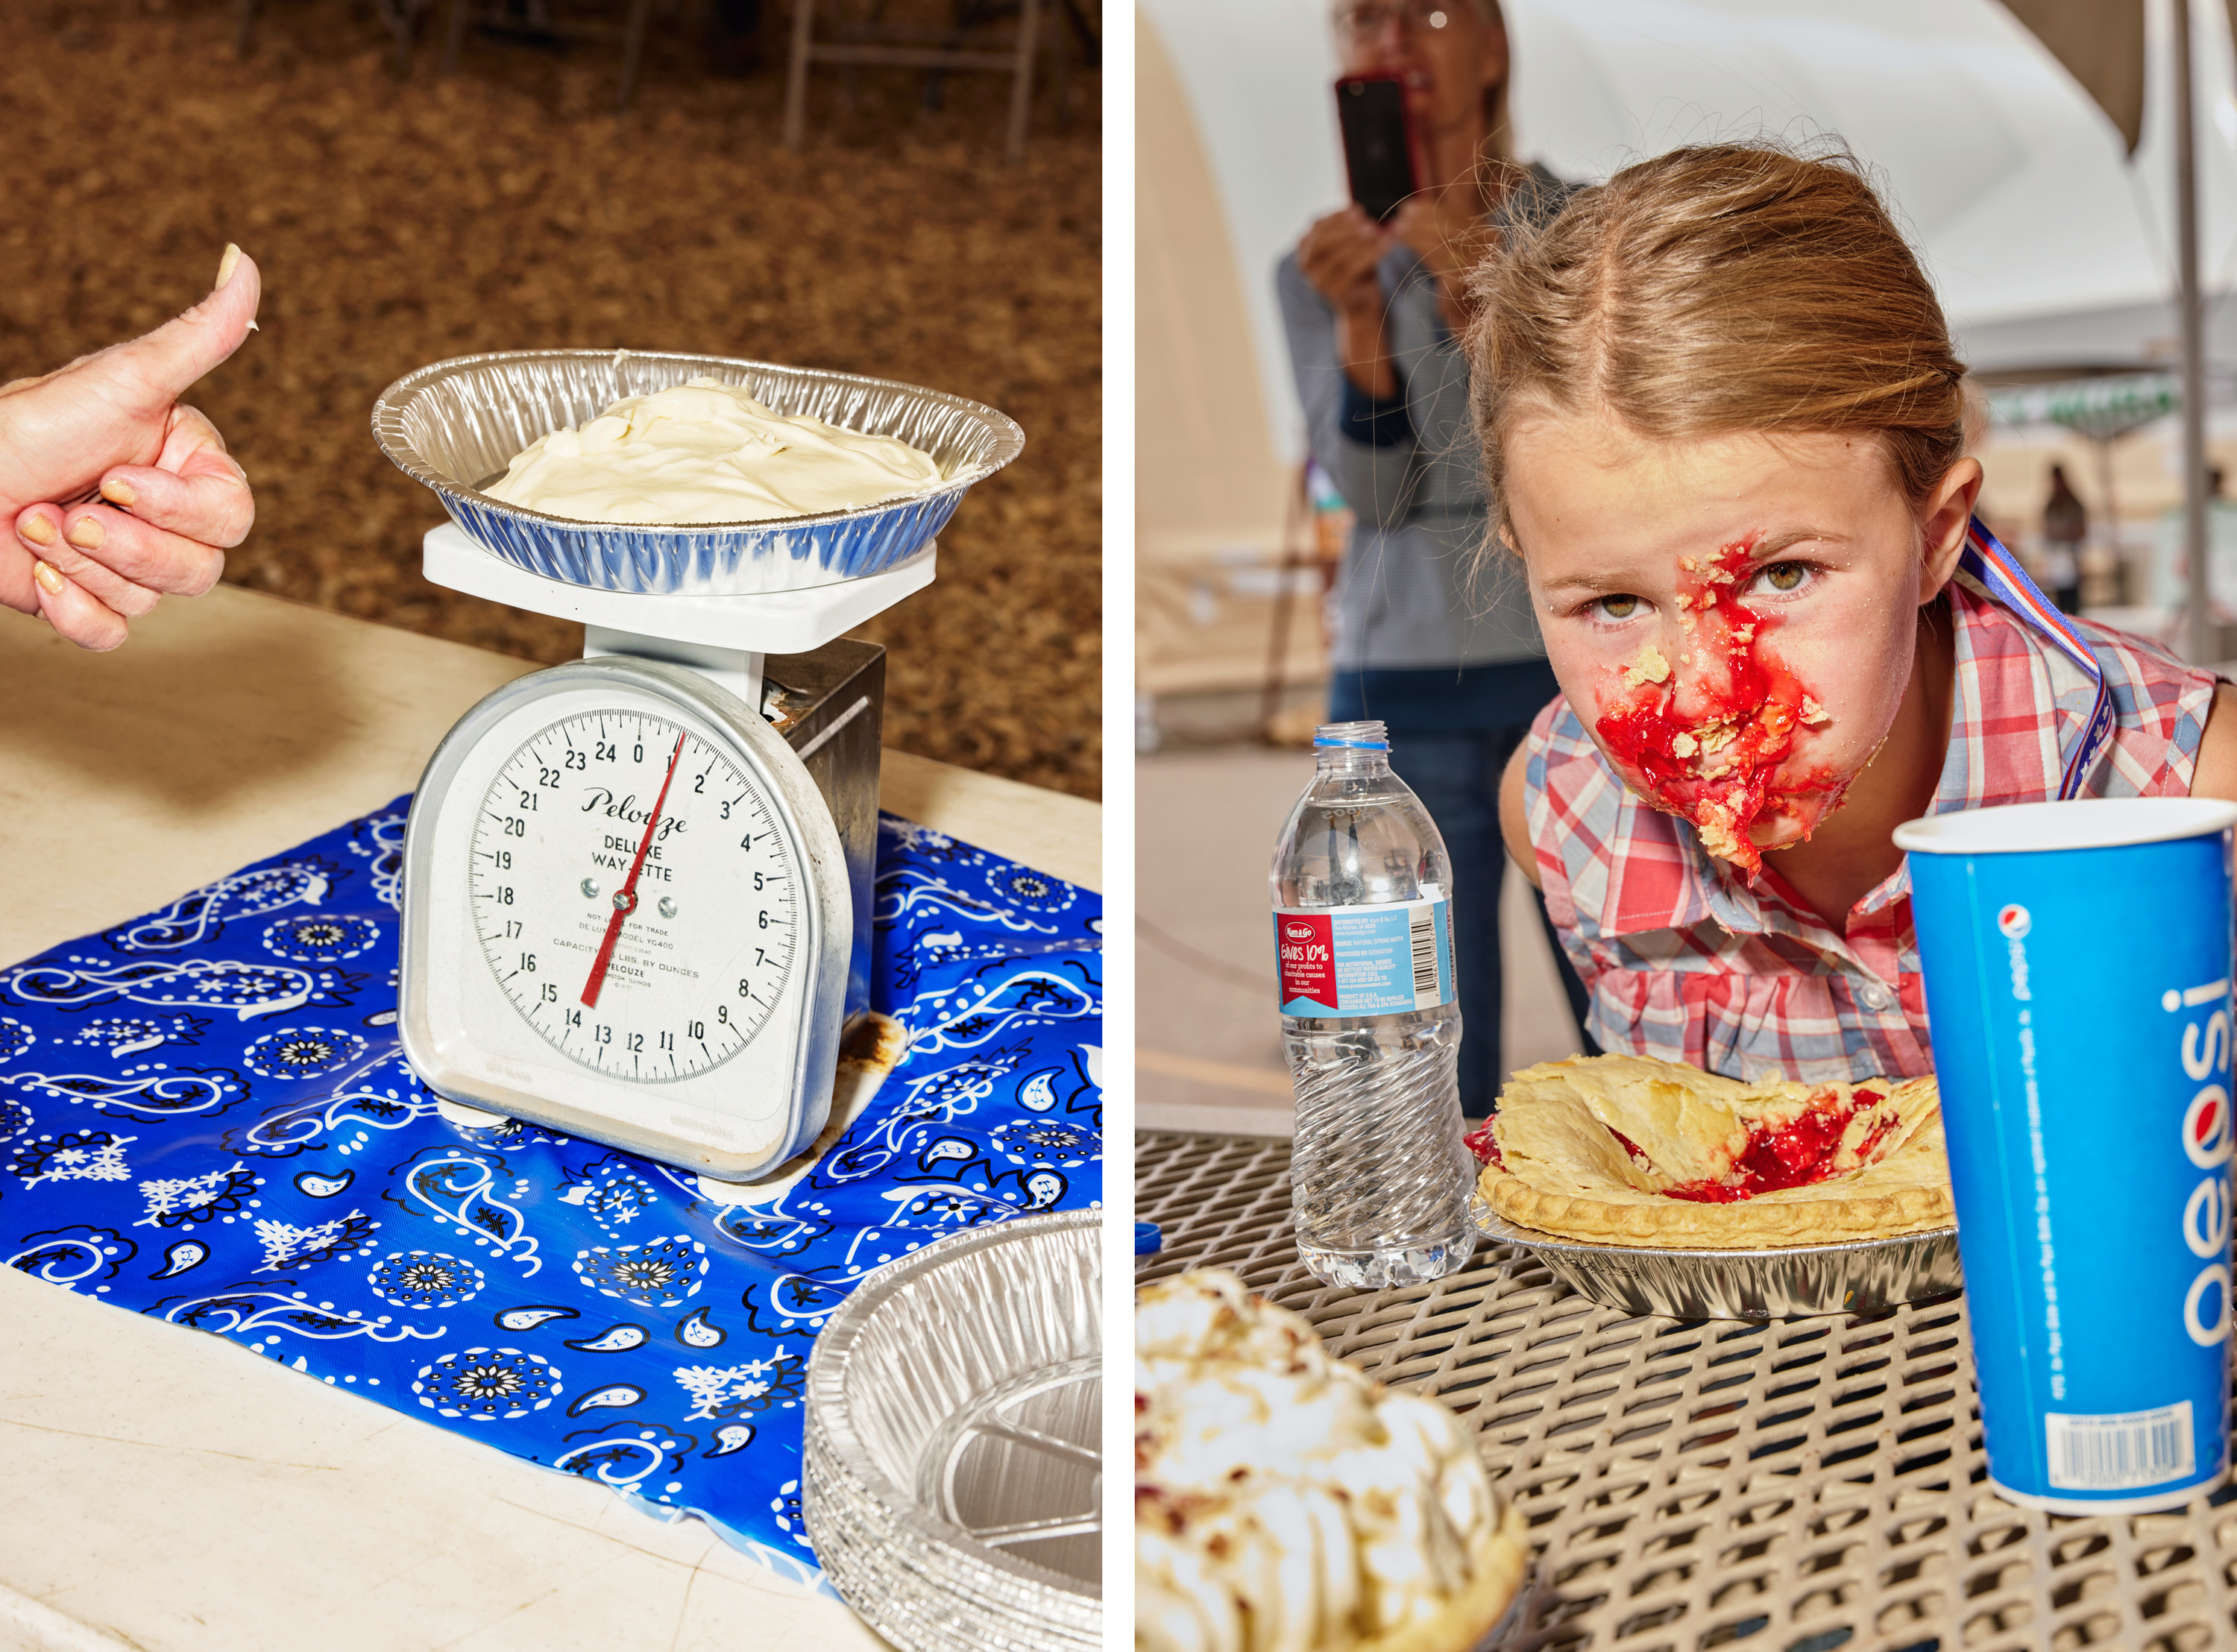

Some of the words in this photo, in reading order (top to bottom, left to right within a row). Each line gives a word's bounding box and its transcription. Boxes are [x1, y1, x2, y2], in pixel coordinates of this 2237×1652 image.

[565, 749, 586, 771] 23
[595, 741, 617, 763] 24
[633, 743, 644, 763] 0
[539, 767, 561, 789] 22
[694, 774, 705, 795] 2
[520, 790, 538, 812] 21
[720, 801, 730, 820] 3
[582, 786, 689, 842] Pelouze
[504, 816, 525, 838] 20
[605, 835, 663, 860] DELUXE
[740, 833, 751, 852] 4
[495, 850, 512, 870] 19
[754, 871, 764, 891] 5
[497, 885, 514, 905] 18
[506, 920, 523, 939] 17
[629, 922, 643, 930] FOR
[646, 927, 669, 936] TRADE
[758, 909, 768, 930] 6
[579, 922, 589, 930] DE
[647, 938, 673, 950] YG400
[1287, 927, 1298, 936] Kum
[1303, 928, 1312, 936] Go
[520, 952, 537, 972] 16
[553, 938, 600, 954] CAPACITY
[619, 953, 640, 965] LBS.
[643, 959, 655, 968] BY
[658, 963, 699, 979] OUNCES
[755, 948, 765, 966] 7
[1306, 945, 1329, 961] 10%
[1284, 969, 1305, 977] charitable
[1298, 962, 1315, 970] profits
[541, 983, 557, 1003] 15
[738, 979, 749, 997] 8
[565, 1007, 582, 1028] 14
[718, 1005, 728, 1024] 9
[594, 1024, 611, 1044] 13
[688, 1019, 705, 1040] 10
[626, 1032, 644, 1053] 12
[659, 1030, 673, 1051] 11
